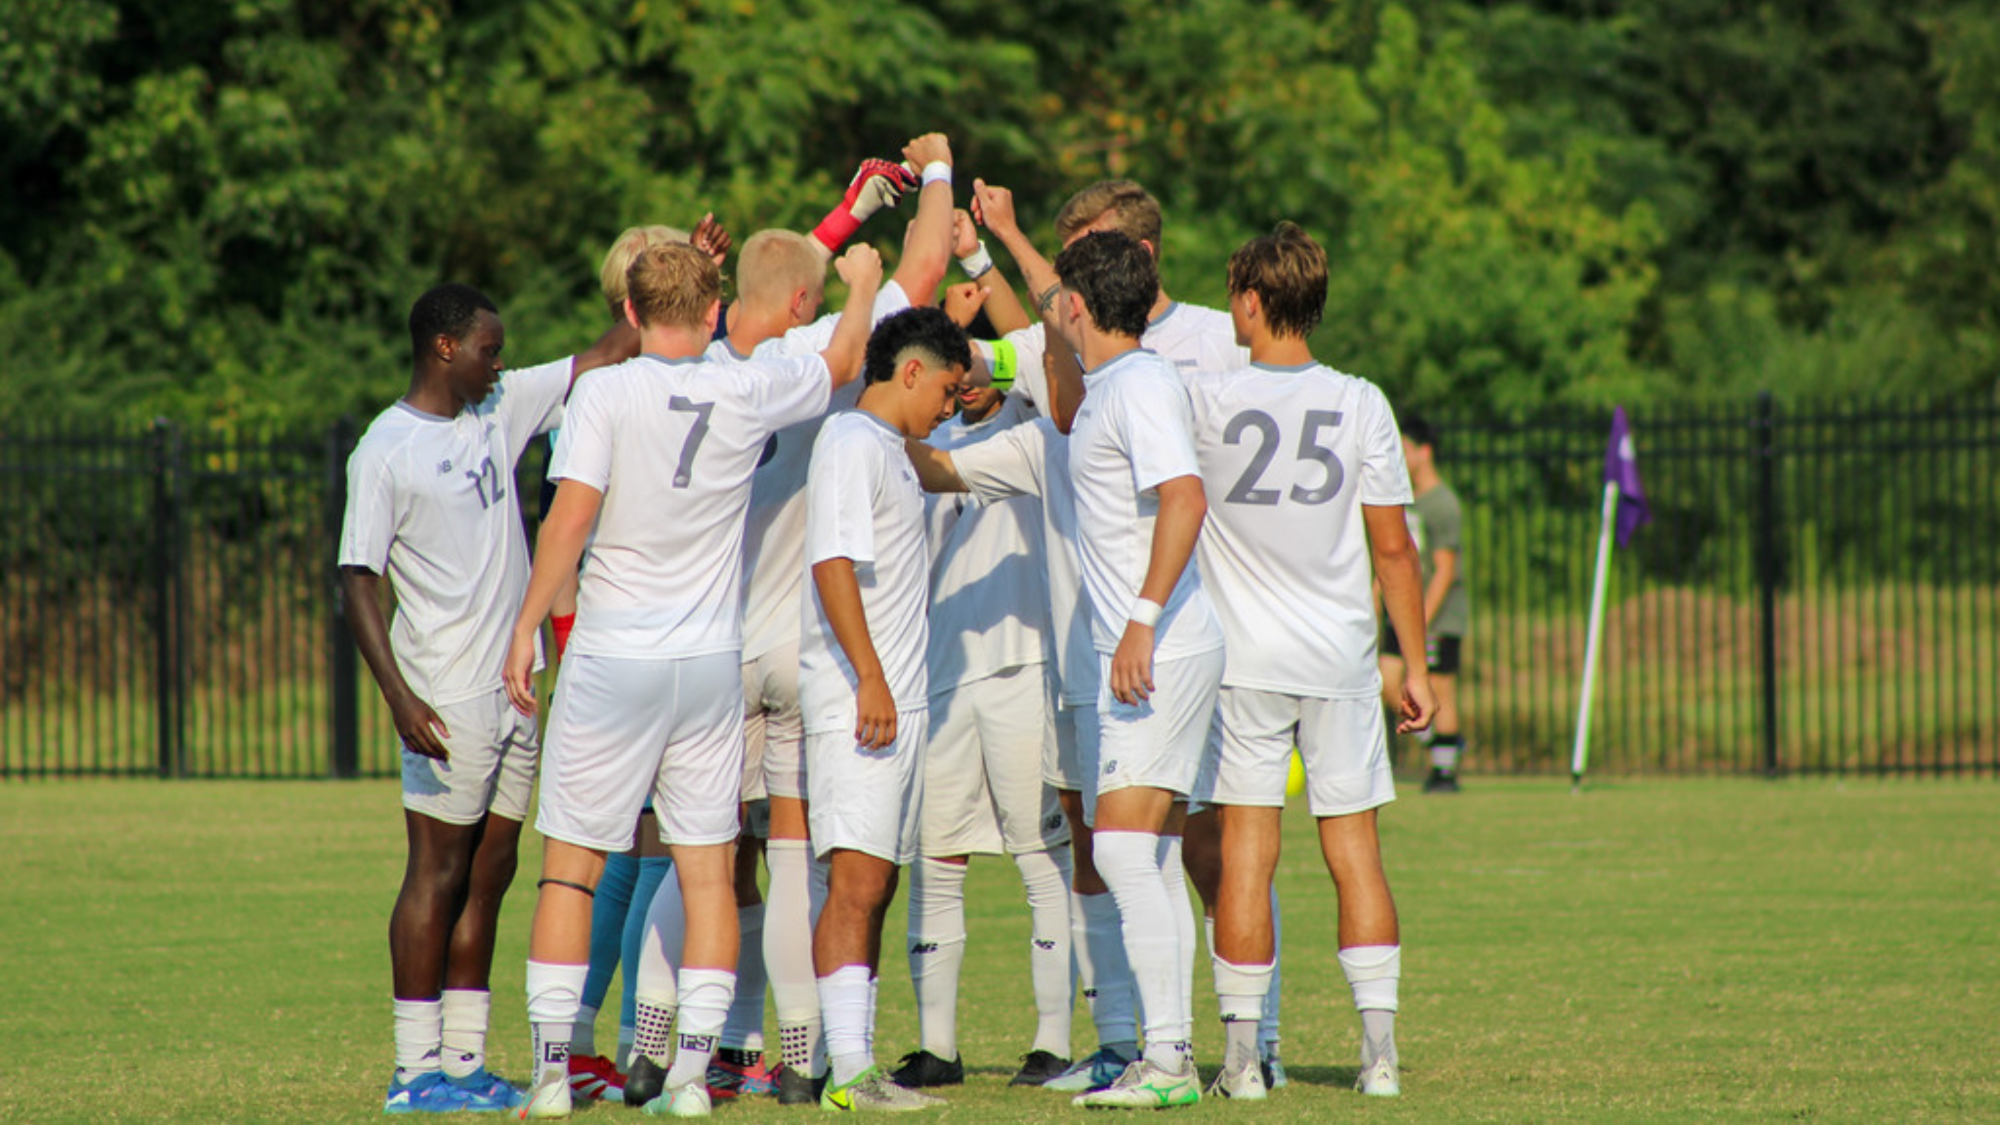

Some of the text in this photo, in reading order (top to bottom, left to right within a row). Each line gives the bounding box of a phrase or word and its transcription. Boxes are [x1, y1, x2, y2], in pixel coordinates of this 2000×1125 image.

[465, 456, 505, 510] 12
[668, 395, 715, 489] 7
[1222, 409, 1344, 505] 25
